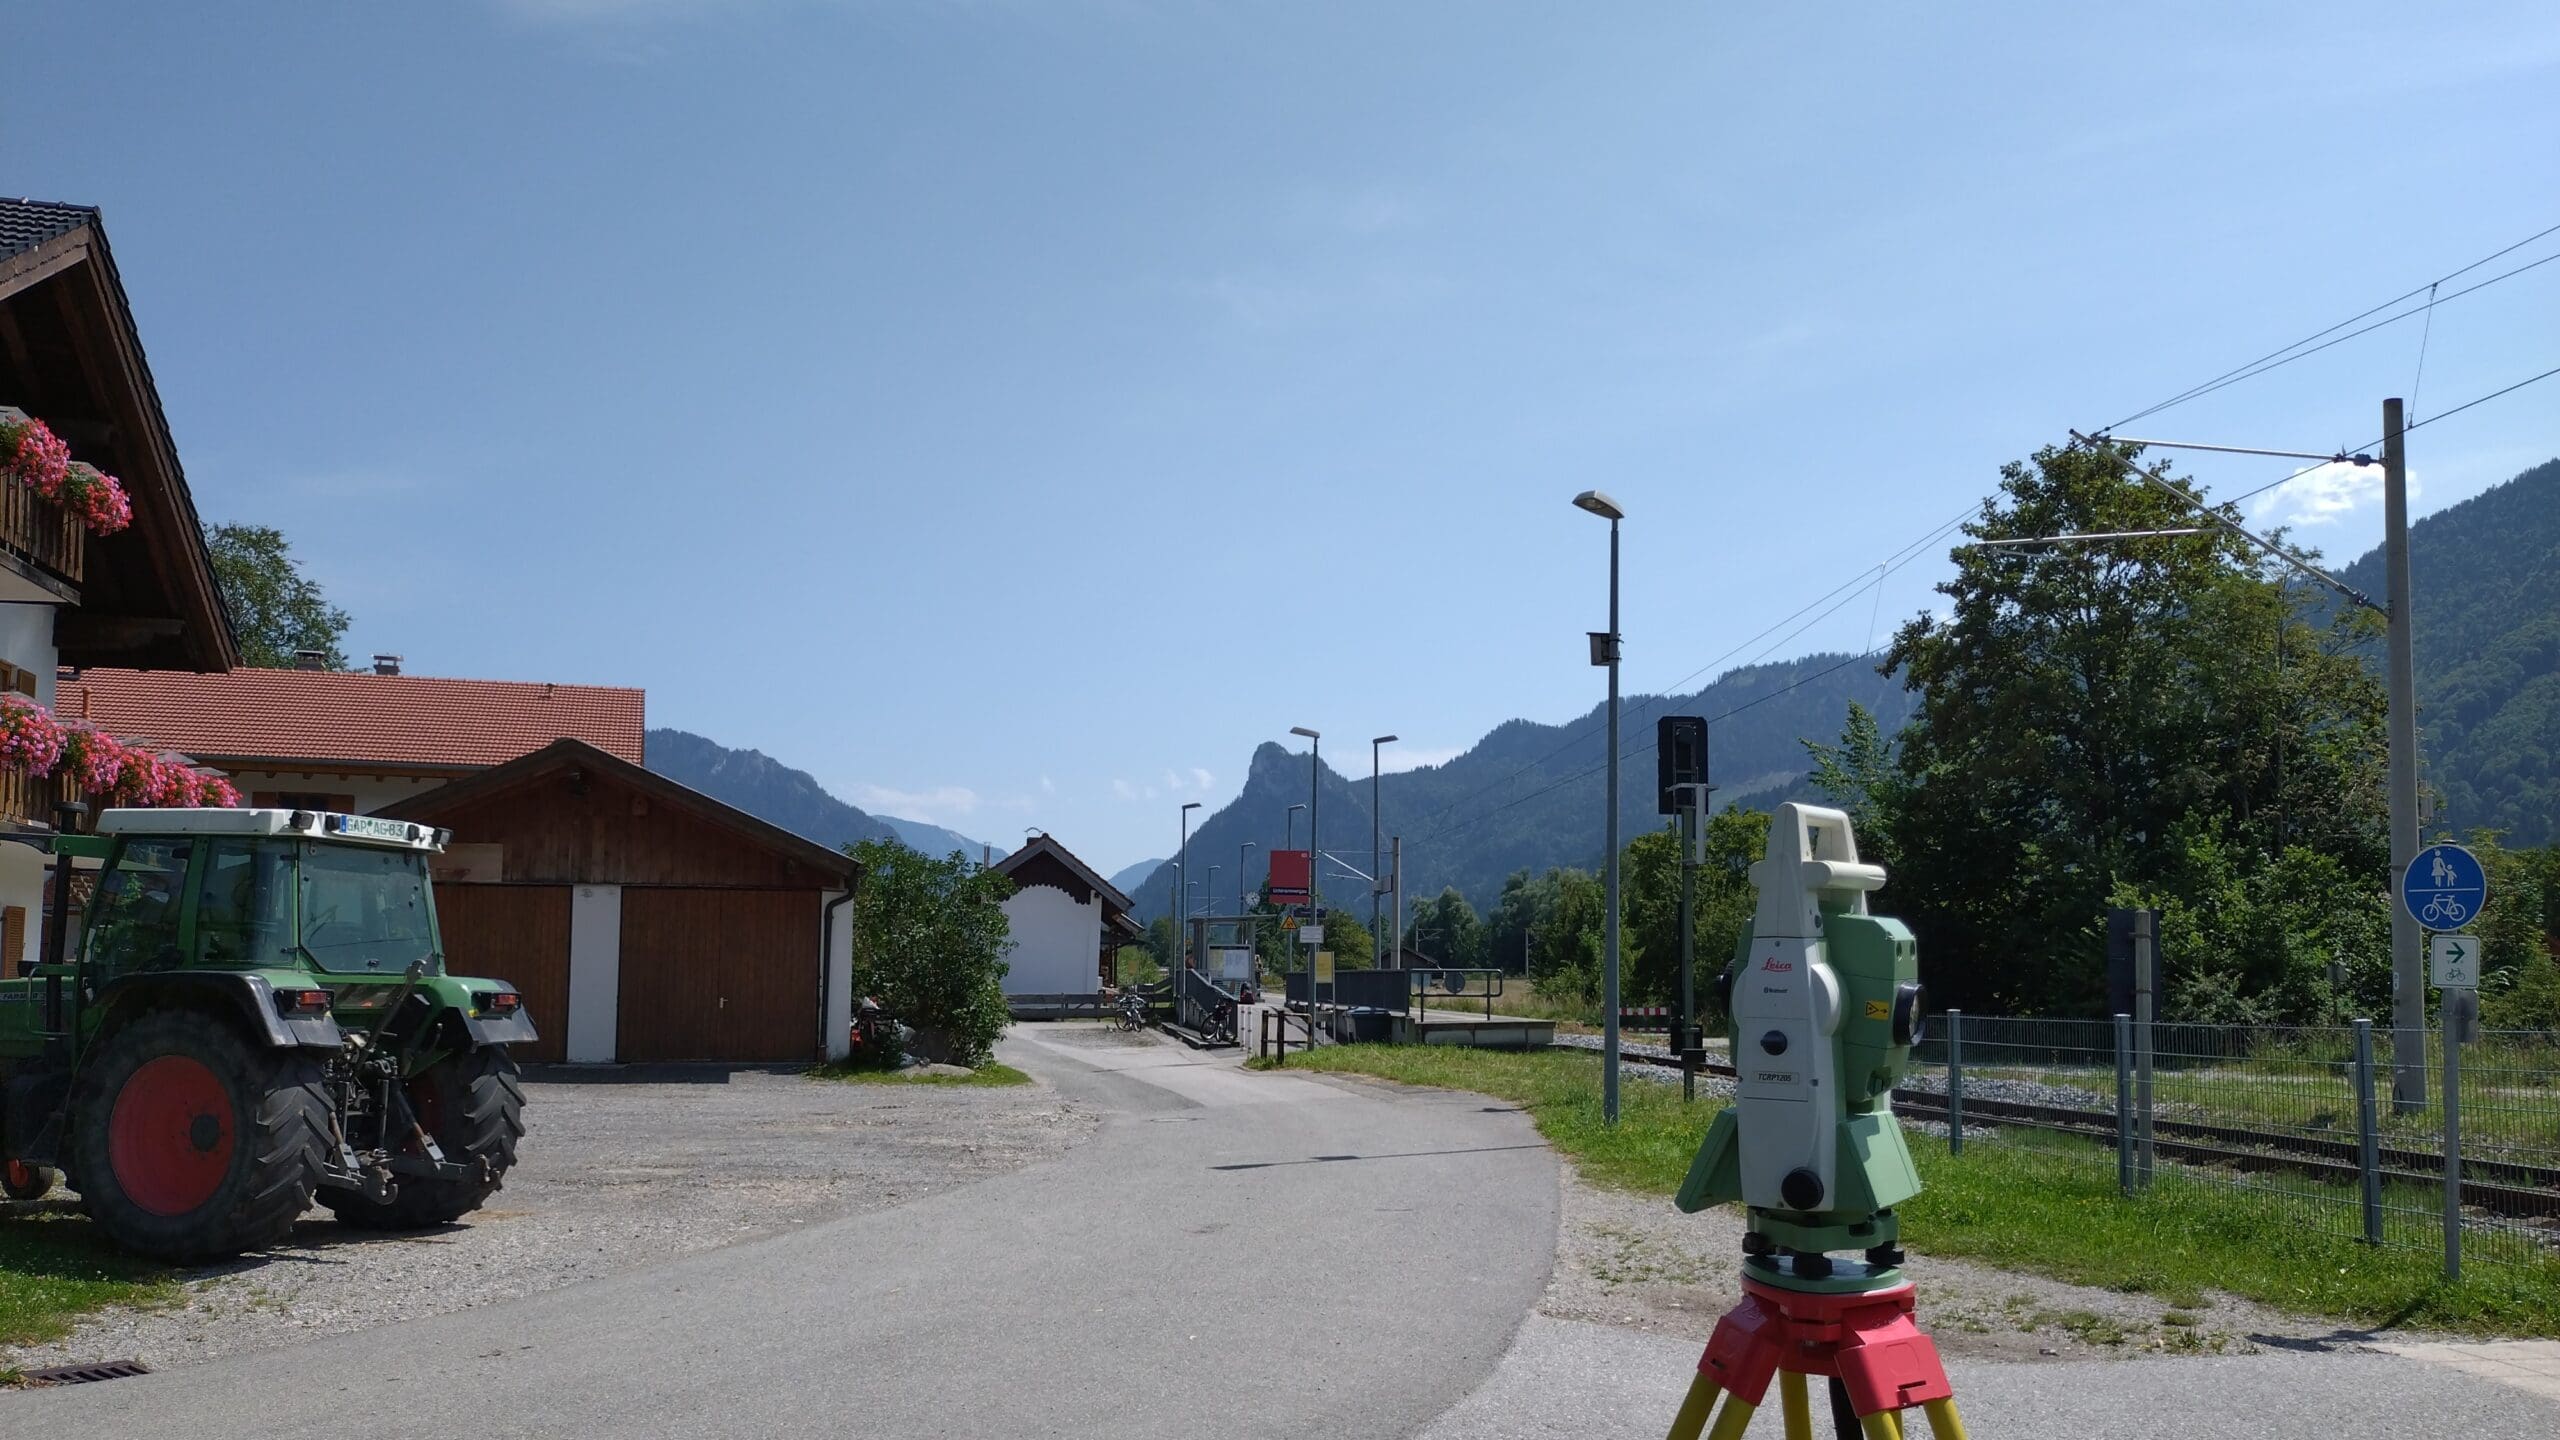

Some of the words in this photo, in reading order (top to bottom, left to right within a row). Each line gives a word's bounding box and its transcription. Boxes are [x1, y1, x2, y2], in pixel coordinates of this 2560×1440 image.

[347, 818, 366, 832] GAP
[388, 824, 403, 836] 83
[1760, 957, 1792, 972] Leica
